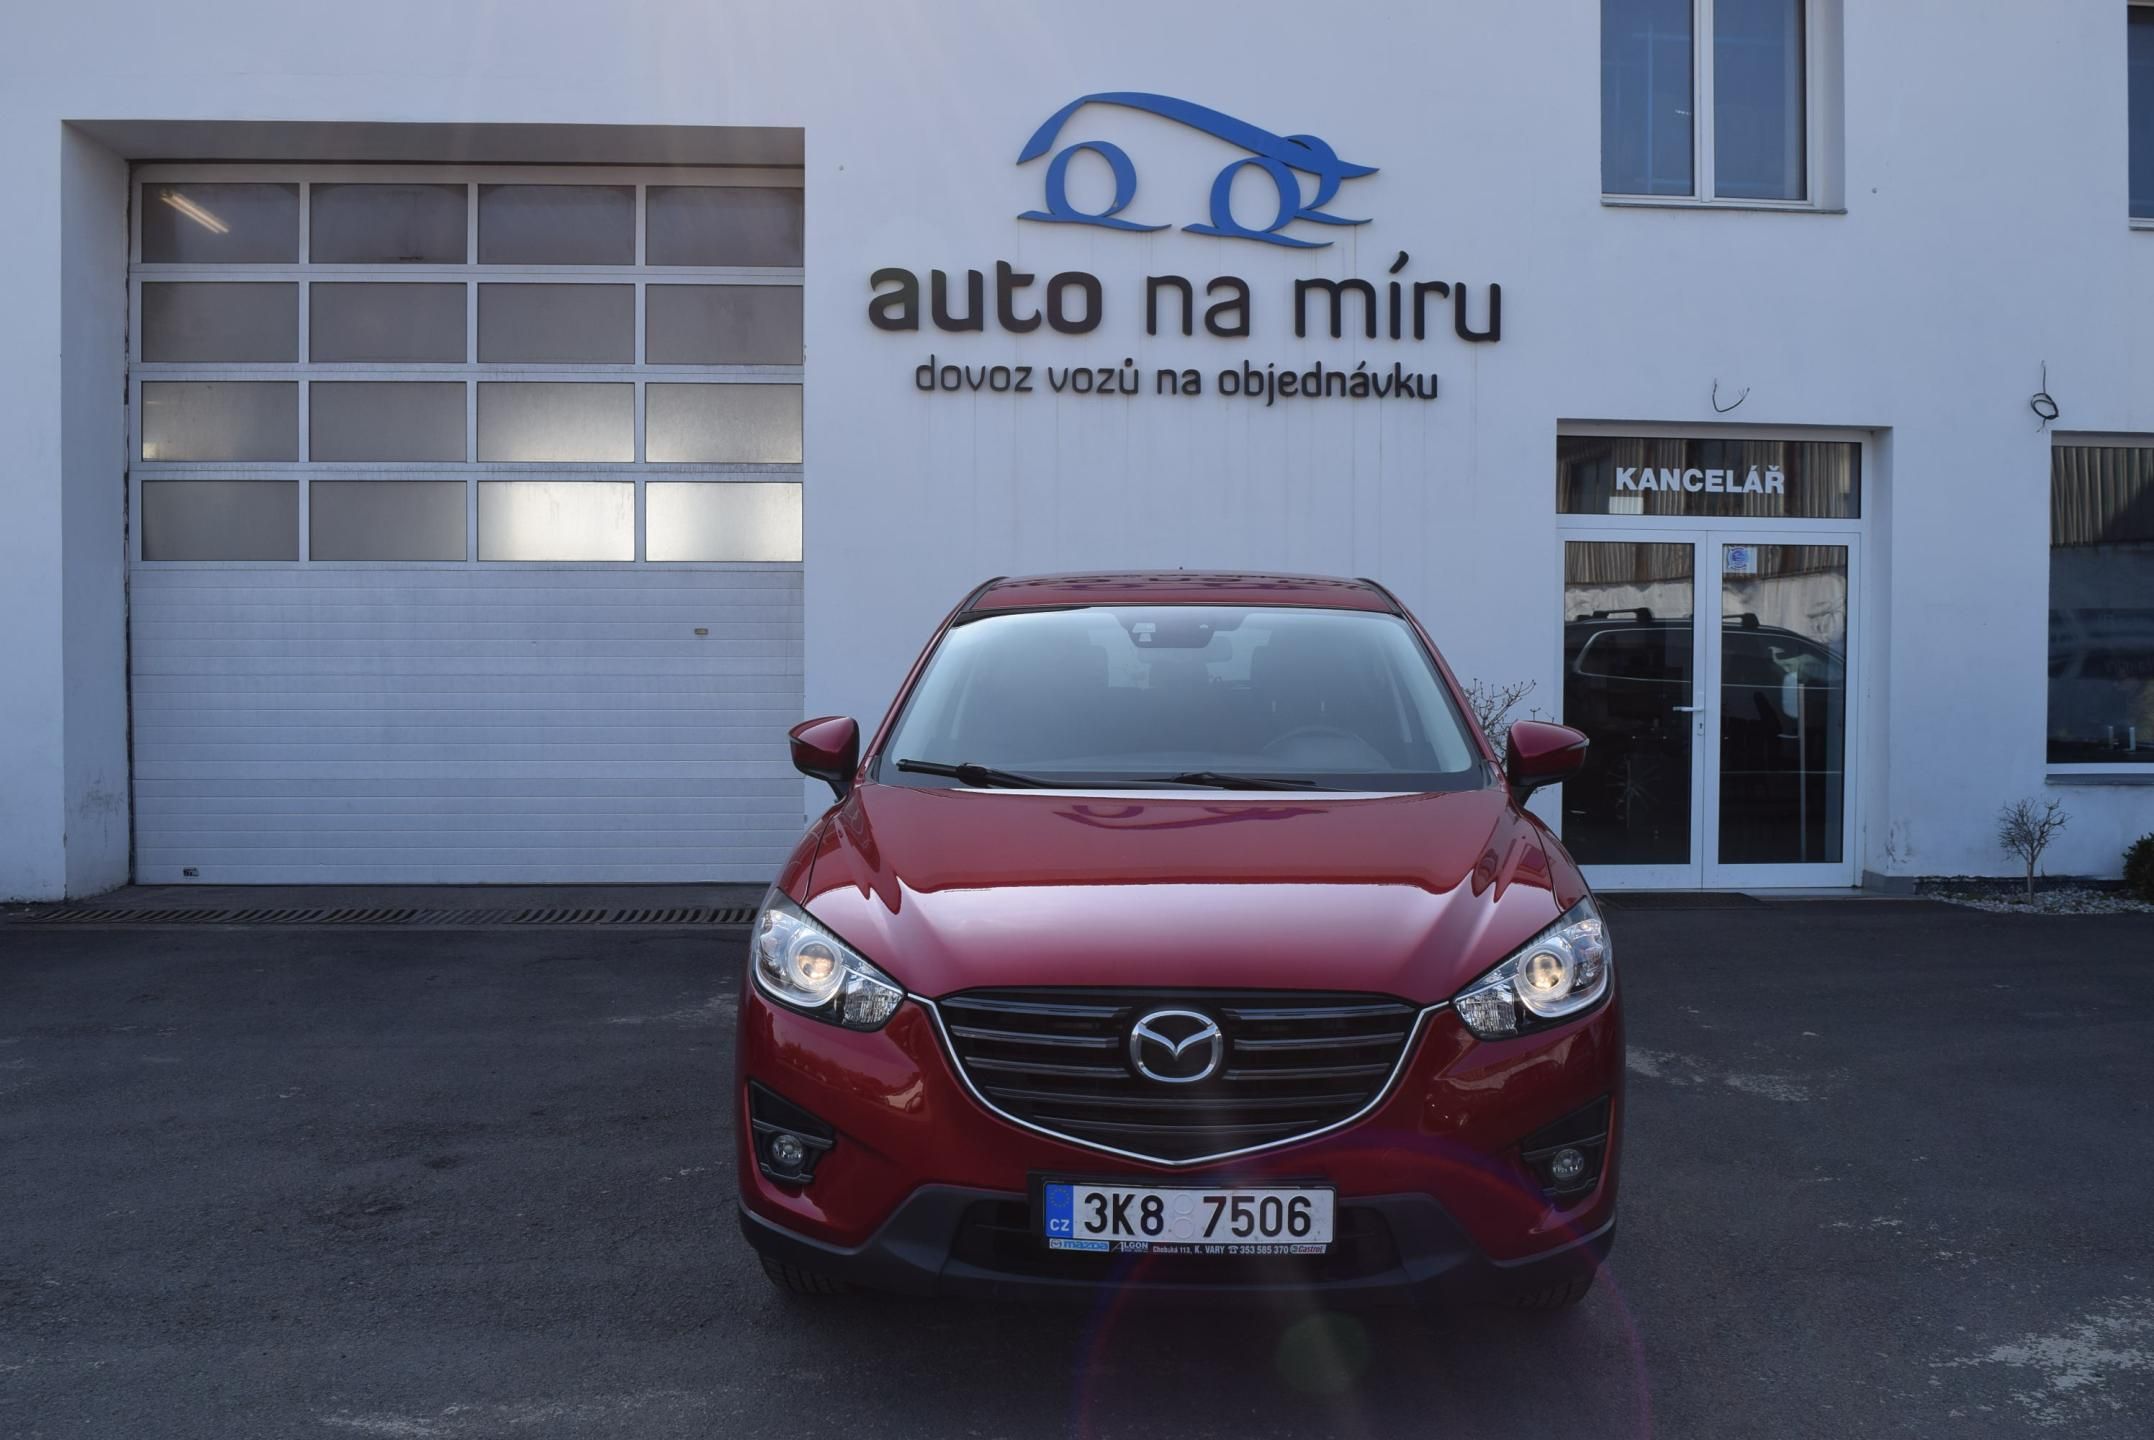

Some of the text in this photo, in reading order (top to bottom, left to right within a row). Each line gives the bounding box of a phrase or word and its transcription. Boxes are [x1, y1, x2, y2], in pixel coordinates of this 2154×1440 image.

[868, 250, 1501, 342] auto na míru
[914, 354, 1438, 406] dovoz vozů na objednávku
[1615, 465, 1785, 494] KANCELÁŘ
[1049, 1218, 1070, 1232] CZ
[1084, 1192, 1312, 1238] 3K8 7506
[1205, 1245, 1225, 1254] VARY
[1239, 1245, 1255, 1254] 353
[1274, 1245, 1289, 1255] 370
